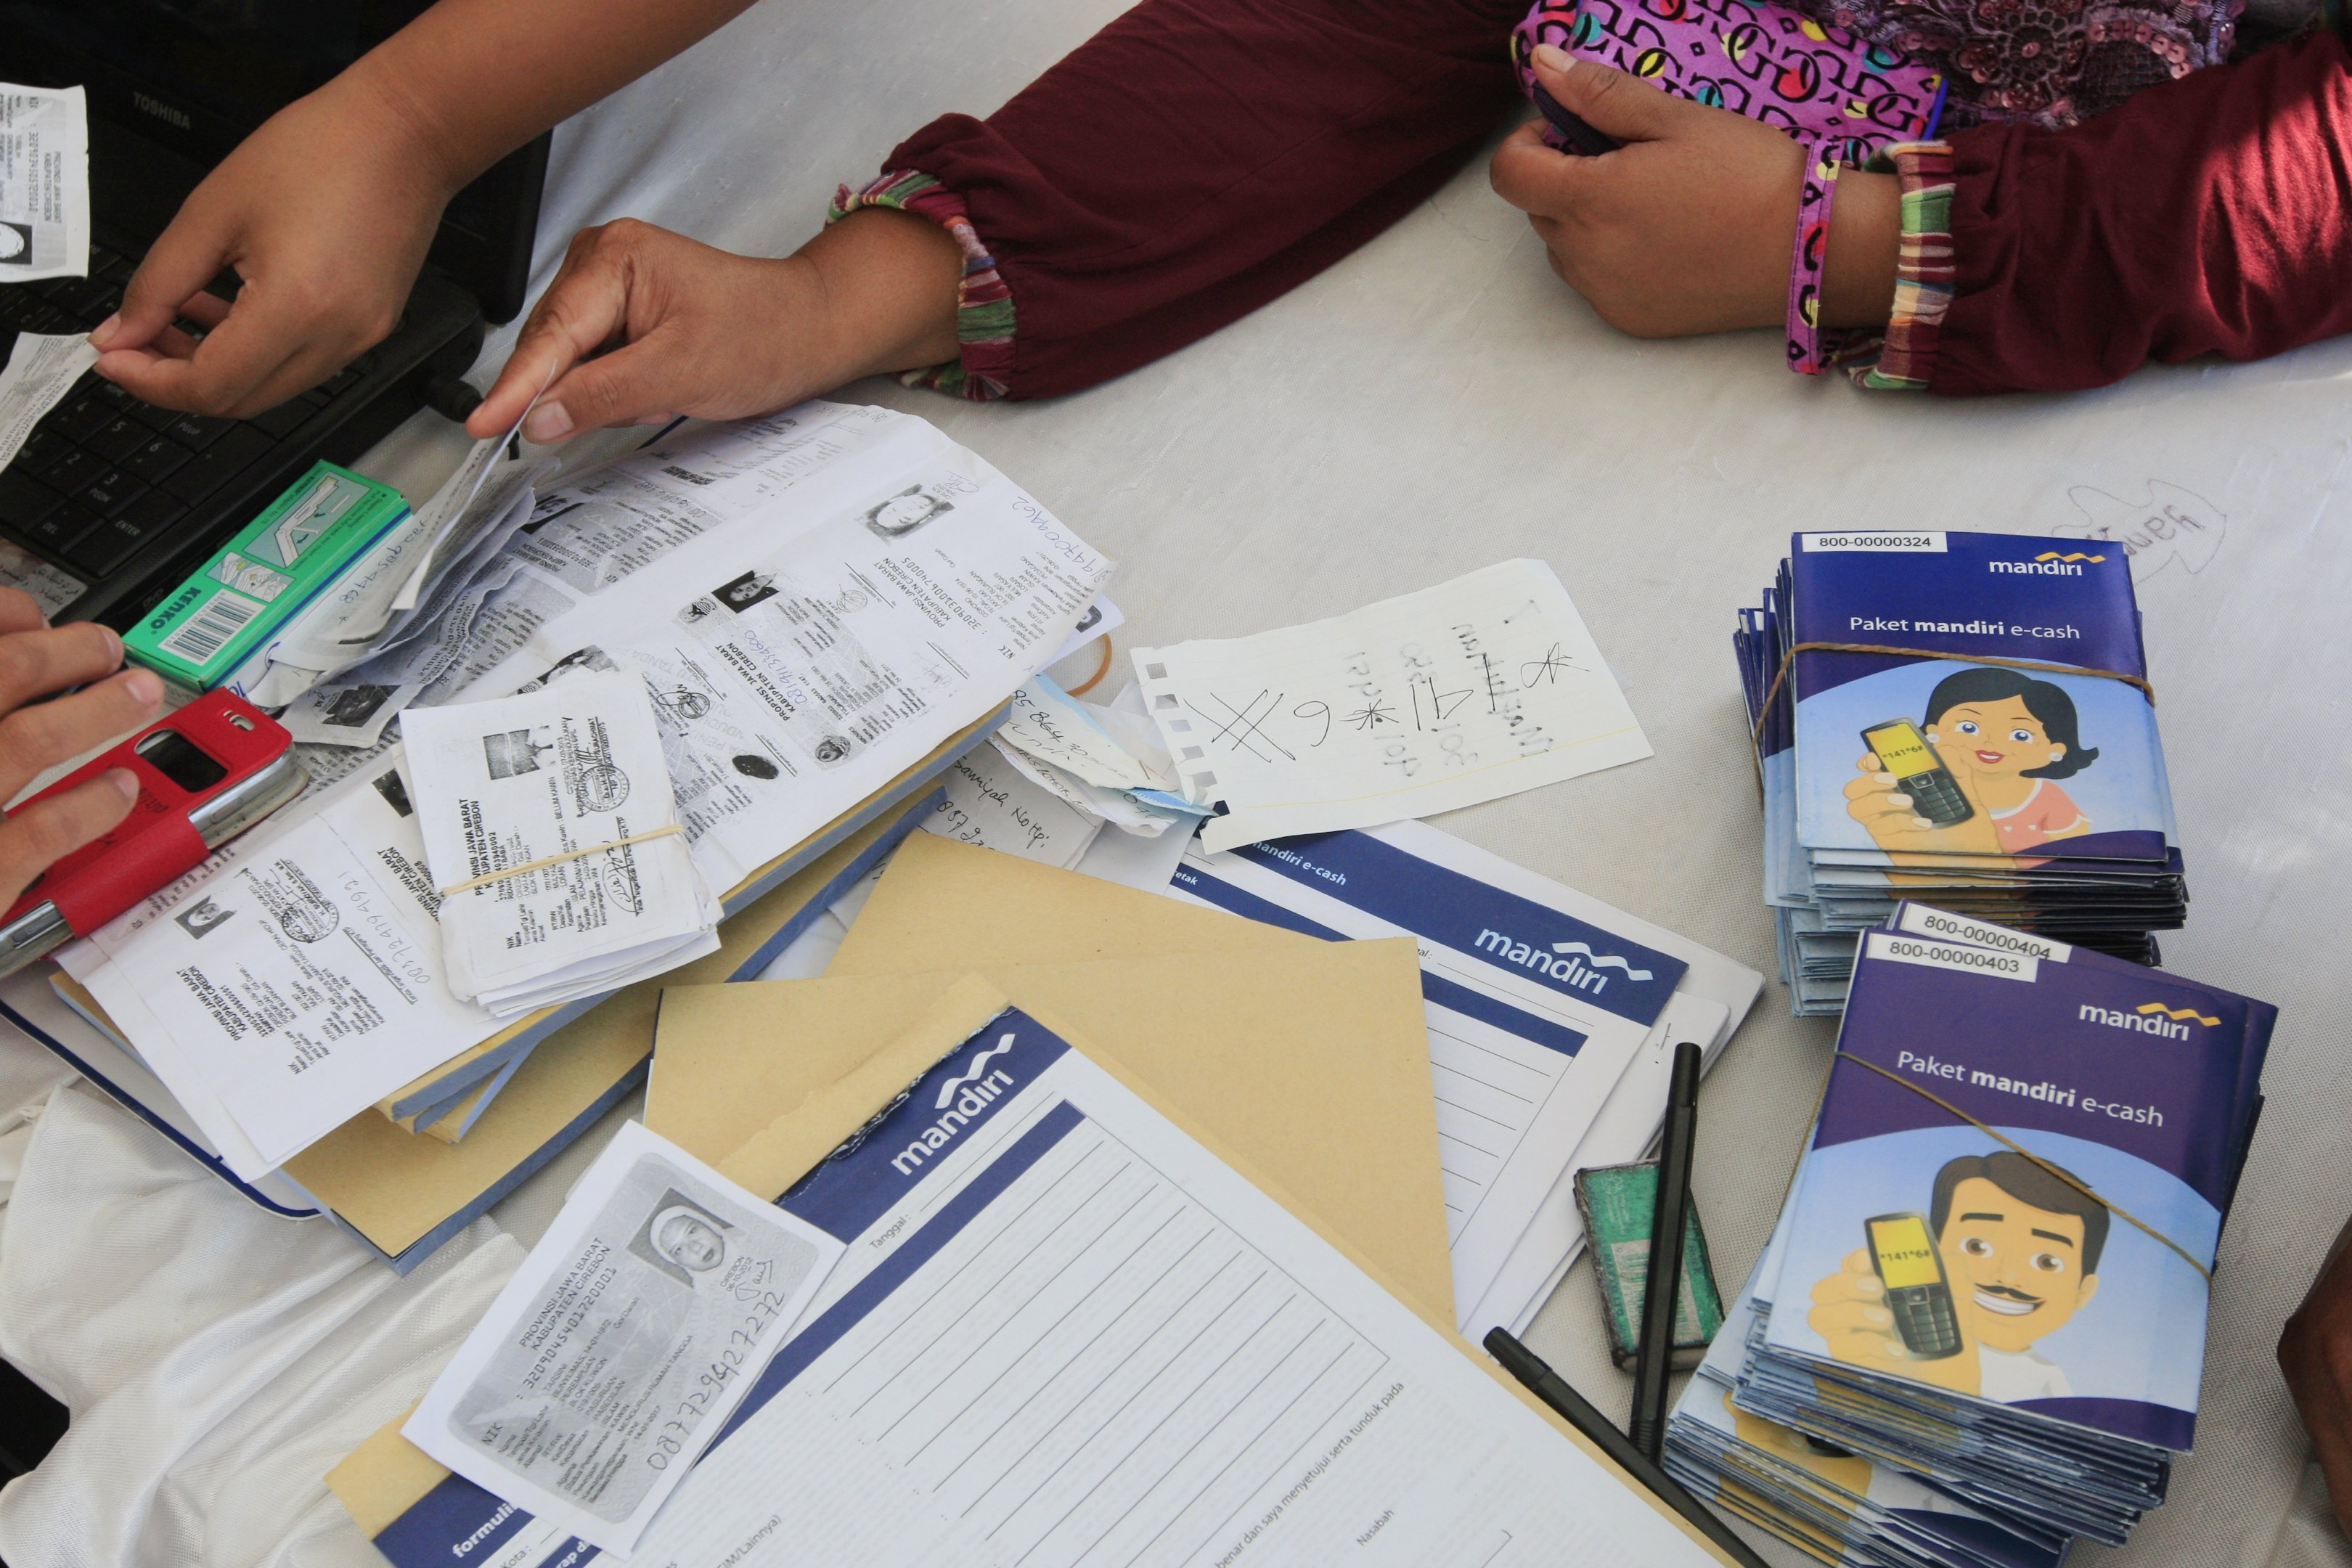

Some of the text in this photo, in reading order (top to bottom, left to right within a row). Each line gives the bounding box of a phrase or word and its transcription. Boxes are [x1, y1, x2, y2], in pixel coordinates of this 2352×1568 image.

[131, 91, 191, 131] TOSHIBA
[113, 420, 127, 433] 5
[67, 453, 81, 465] 2
[149, 441, 163, 452] 6
[104, 473, 118, 485] 3
[42, 521, 59, 536] DEL
[115, 520, 140, 536] ENTER
[1818, 536, 1932, 549] 800-00000324
[871, 559, 899, 582] BARAT
[881, 556, 915, 585] CIREBON
[1988, 558, 2083, 576] mandiri
[893, 579, 917, 599] JAWA
[909, 583, 953, 621] KABUPATEN
[910, 596, 947, 628] PROVINSI
[1849, 616, 2081, 640] Paket mandiri e-cash
[714, 642, 740, 666] BARAT
[724, 640, 758, 671] CIREBON
[996, 644, 1016, 660] NIK
[734, 663, 759, 685] JAWA
[754, 671, 797, 712] KABUPATEN
[755, 685, 792, 720] PROPINSI
[458, 796, 477, 855] JAWA BARAT
[469, 799, 484, 838] CIREBON
[375, 846, 420, 894] JAWA BARAT
[385, 845, 418, 879] CIREBON
[1300, 857, 1349, 887] e-cash
[568, 883, 579, 902] ISLAM
[505, 935, 515, 949] NIK
[1923, 913, 2053, 960] 800-00000404
[1473, 920, 1612, 995] mandiri
[1889, 940, 2020, 974] 800-00000403
[176, 967, 243, 1041] PROVINSI JAWA BARAT
[186, 965, 249, 1033] KABUPATEN CIREBON
[326, 995, 344, 1012] ISLAM
[2079, 1001, 2190, 1042] mandiri
[287, 1061, 303, 1074] NIK
[1897, 1049, 2165, 1128] Paket mandiri e-cash
[886, 1063, 1015, 1177] mandiri
[867, 1214, 910, 1254] Tanggal
[518, 1234, 604, 1349] PROVINSI JAWA BARAT
[529, 1243, 612, 1352] KABUPATEN CIREBON
[521, 1263, 618, 1390] 3209045401720001
[558, 1354, 597, 1404] PEREMPUAN
[600, 1400, 622, 1426] ISLAM
[608, 1402, 632, 1431] KAWIN
[481, 1419, 505, 1447] NIK
[1239, 1522, 1265, 1546] dan
[1259, 1503, 1286, 1529] saya
[1277, 1454, 1334, 1508] menyetujui
[1326, 1432, 1355, 1460] serta
[1345, 1400, 1385, 1439] tunduk
[1376, 1379, 1408, 1410] pada
[448, 1498, 518, 1560] formuli
[1353, 1506, 1397, 1548] Nasabah
